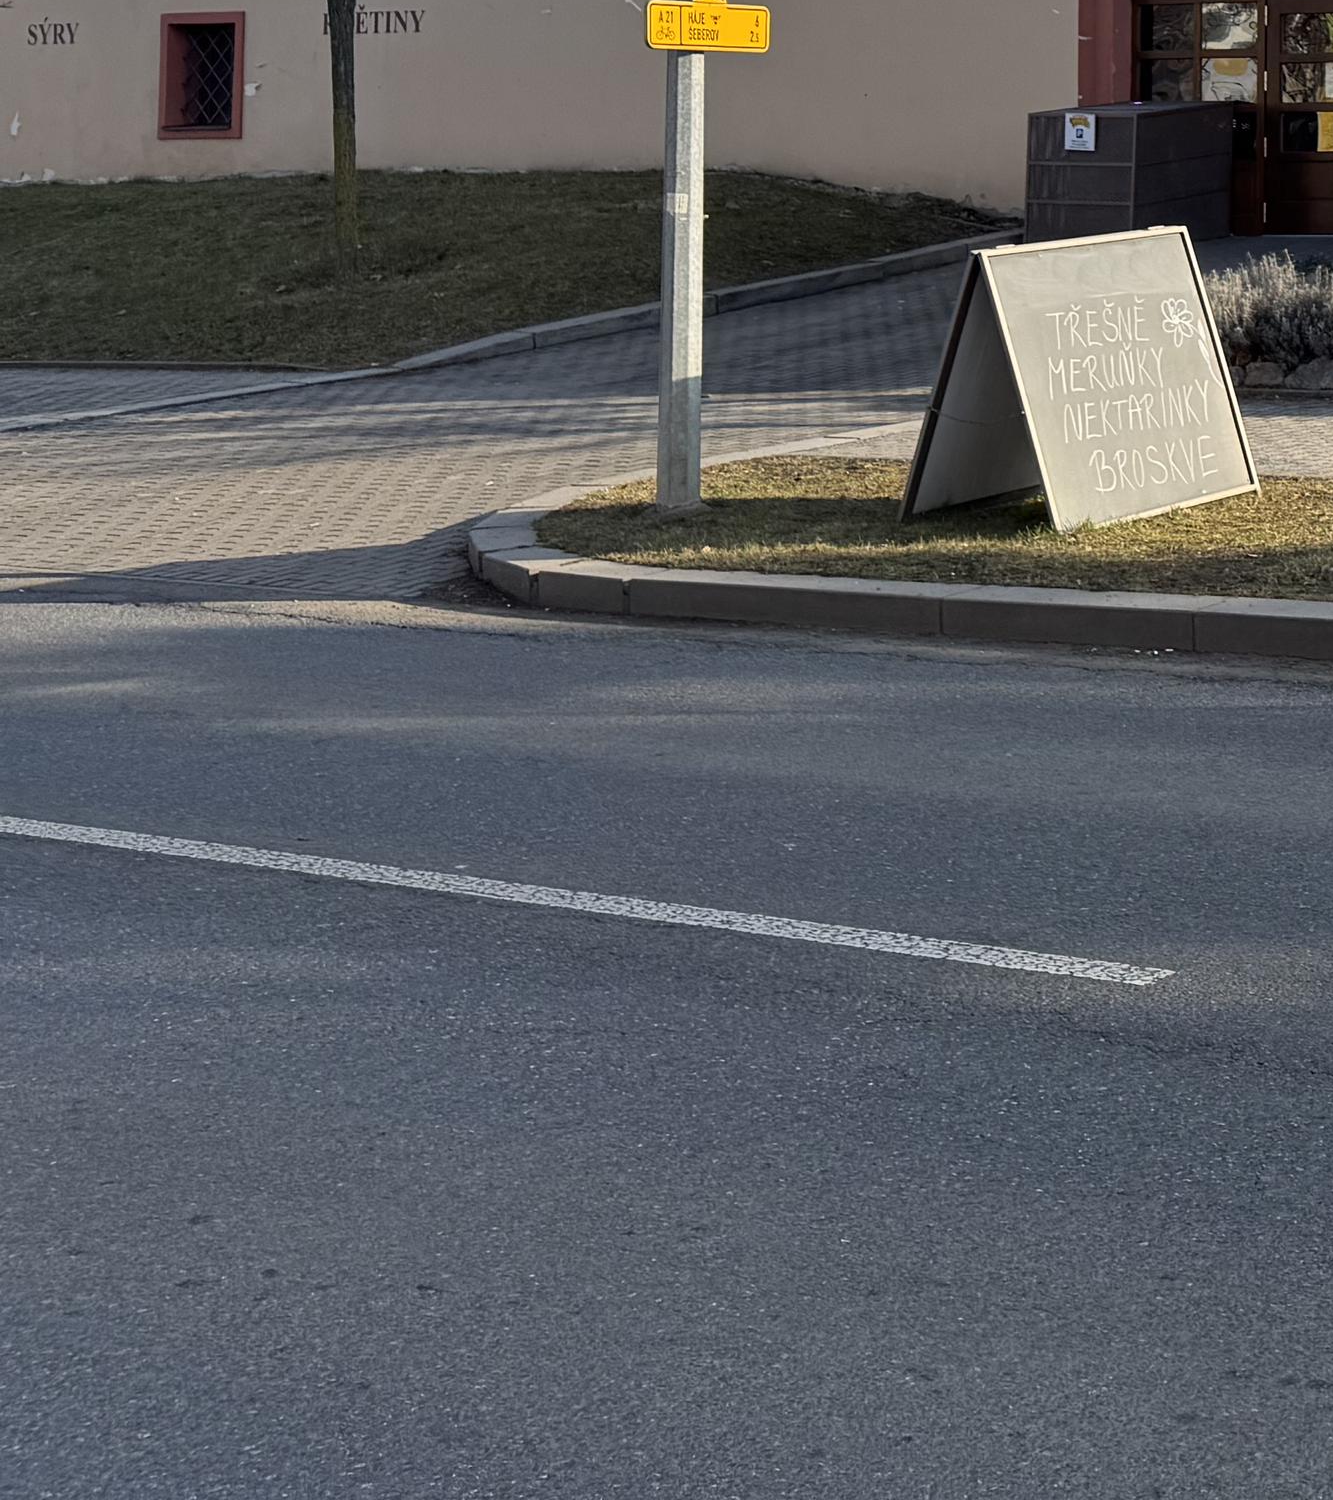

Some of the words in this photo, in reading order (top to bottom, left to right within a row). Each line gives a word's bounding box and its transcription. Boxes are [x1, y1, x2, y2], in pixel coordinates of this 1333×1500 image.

[27, 16, 80, 46] SÝRY
[323, 4, 426, 36] ĚTINY
[666, 11, 673, 23] 21
[1046, 297, 1151, 350] TŘEŠNĚ
[1047, 344, 1165, 401] MERUŇKY
[1063, 379, 1210, 443] NEKTARINKY
[1089, 435, 1219, 494] BROSKVE
